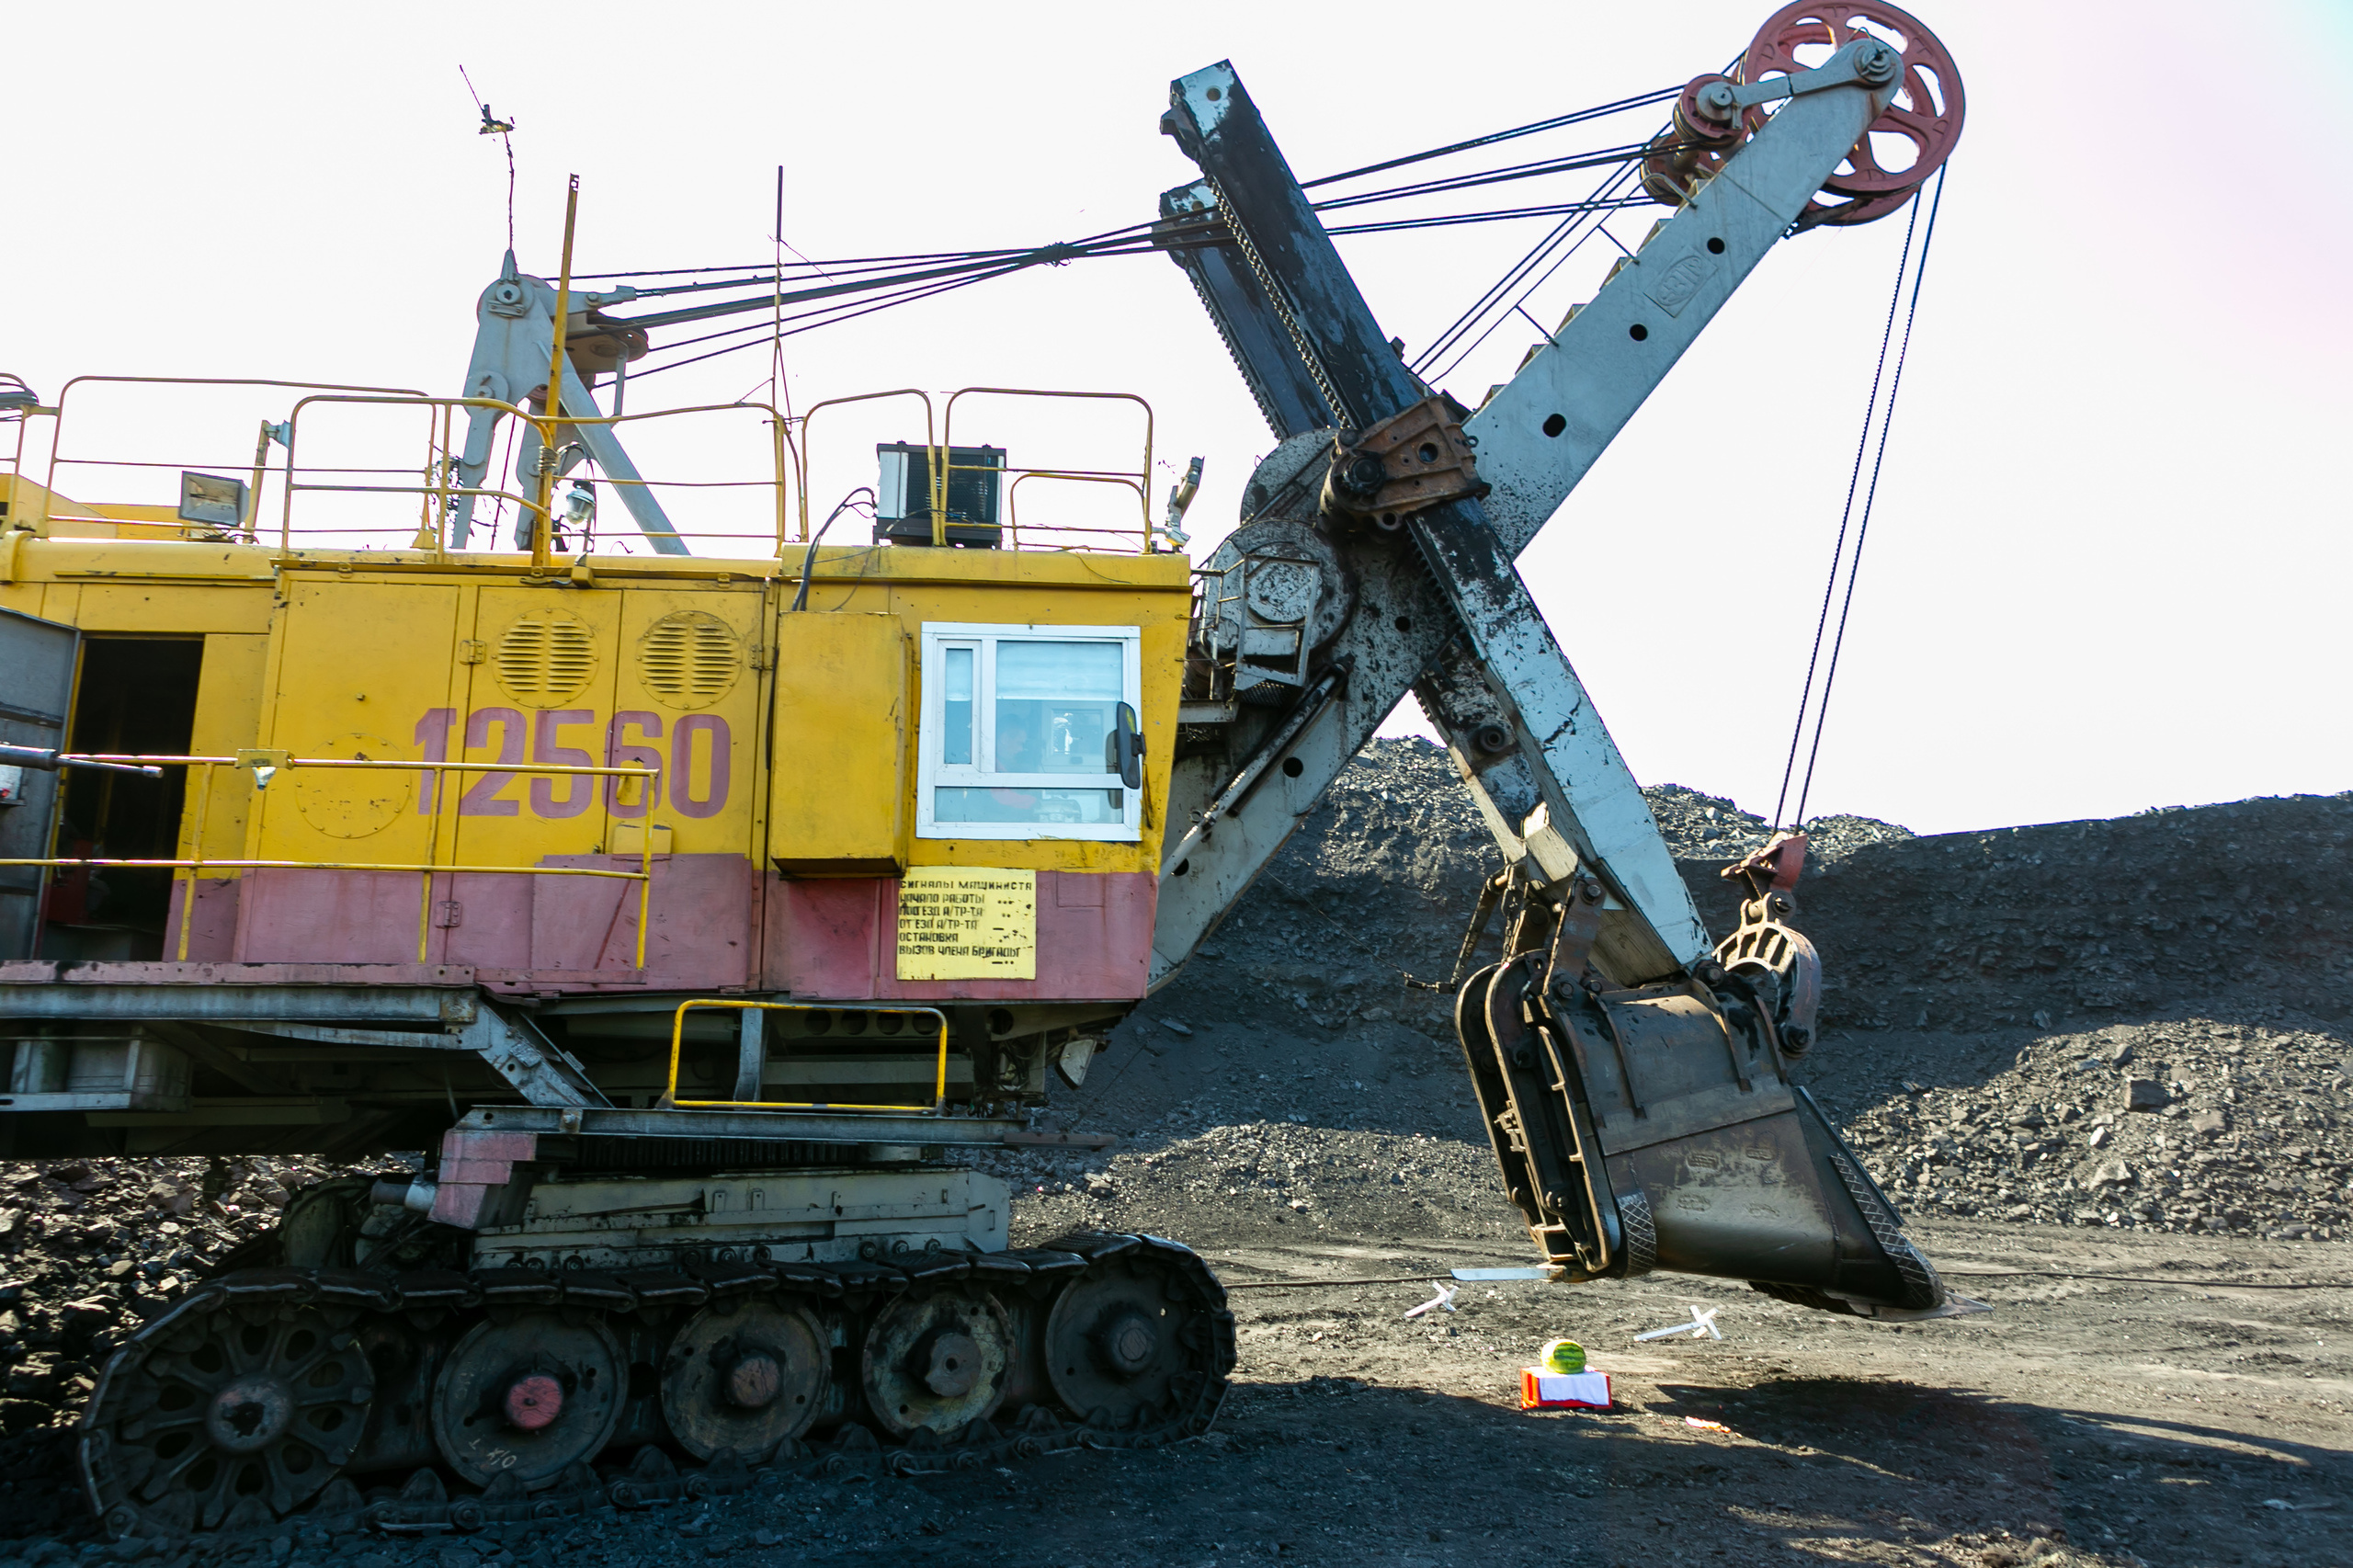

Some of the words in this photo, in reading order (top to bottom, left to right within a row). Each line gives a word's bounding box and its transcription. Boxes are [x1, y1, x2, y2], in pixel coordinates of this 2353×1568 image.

[414, 707, 731, 819] 12560
[900, 880, 954, 889] СИГНАЛЫ
[958, 881, 1032, 891] МАШИНИСТА
[900, 892, 939, 903] НАЧАЛО
[942, 893, 984, 903] РАБОТЫ
[899, 932, 958, 942] ОСТАНОВКА
[899, 945, 935, 955] ВЫЗОВ
[938, 946, 969, 956] ЧЛЕНА
[972, 947, 1019, 957] БРИГАДЫ
